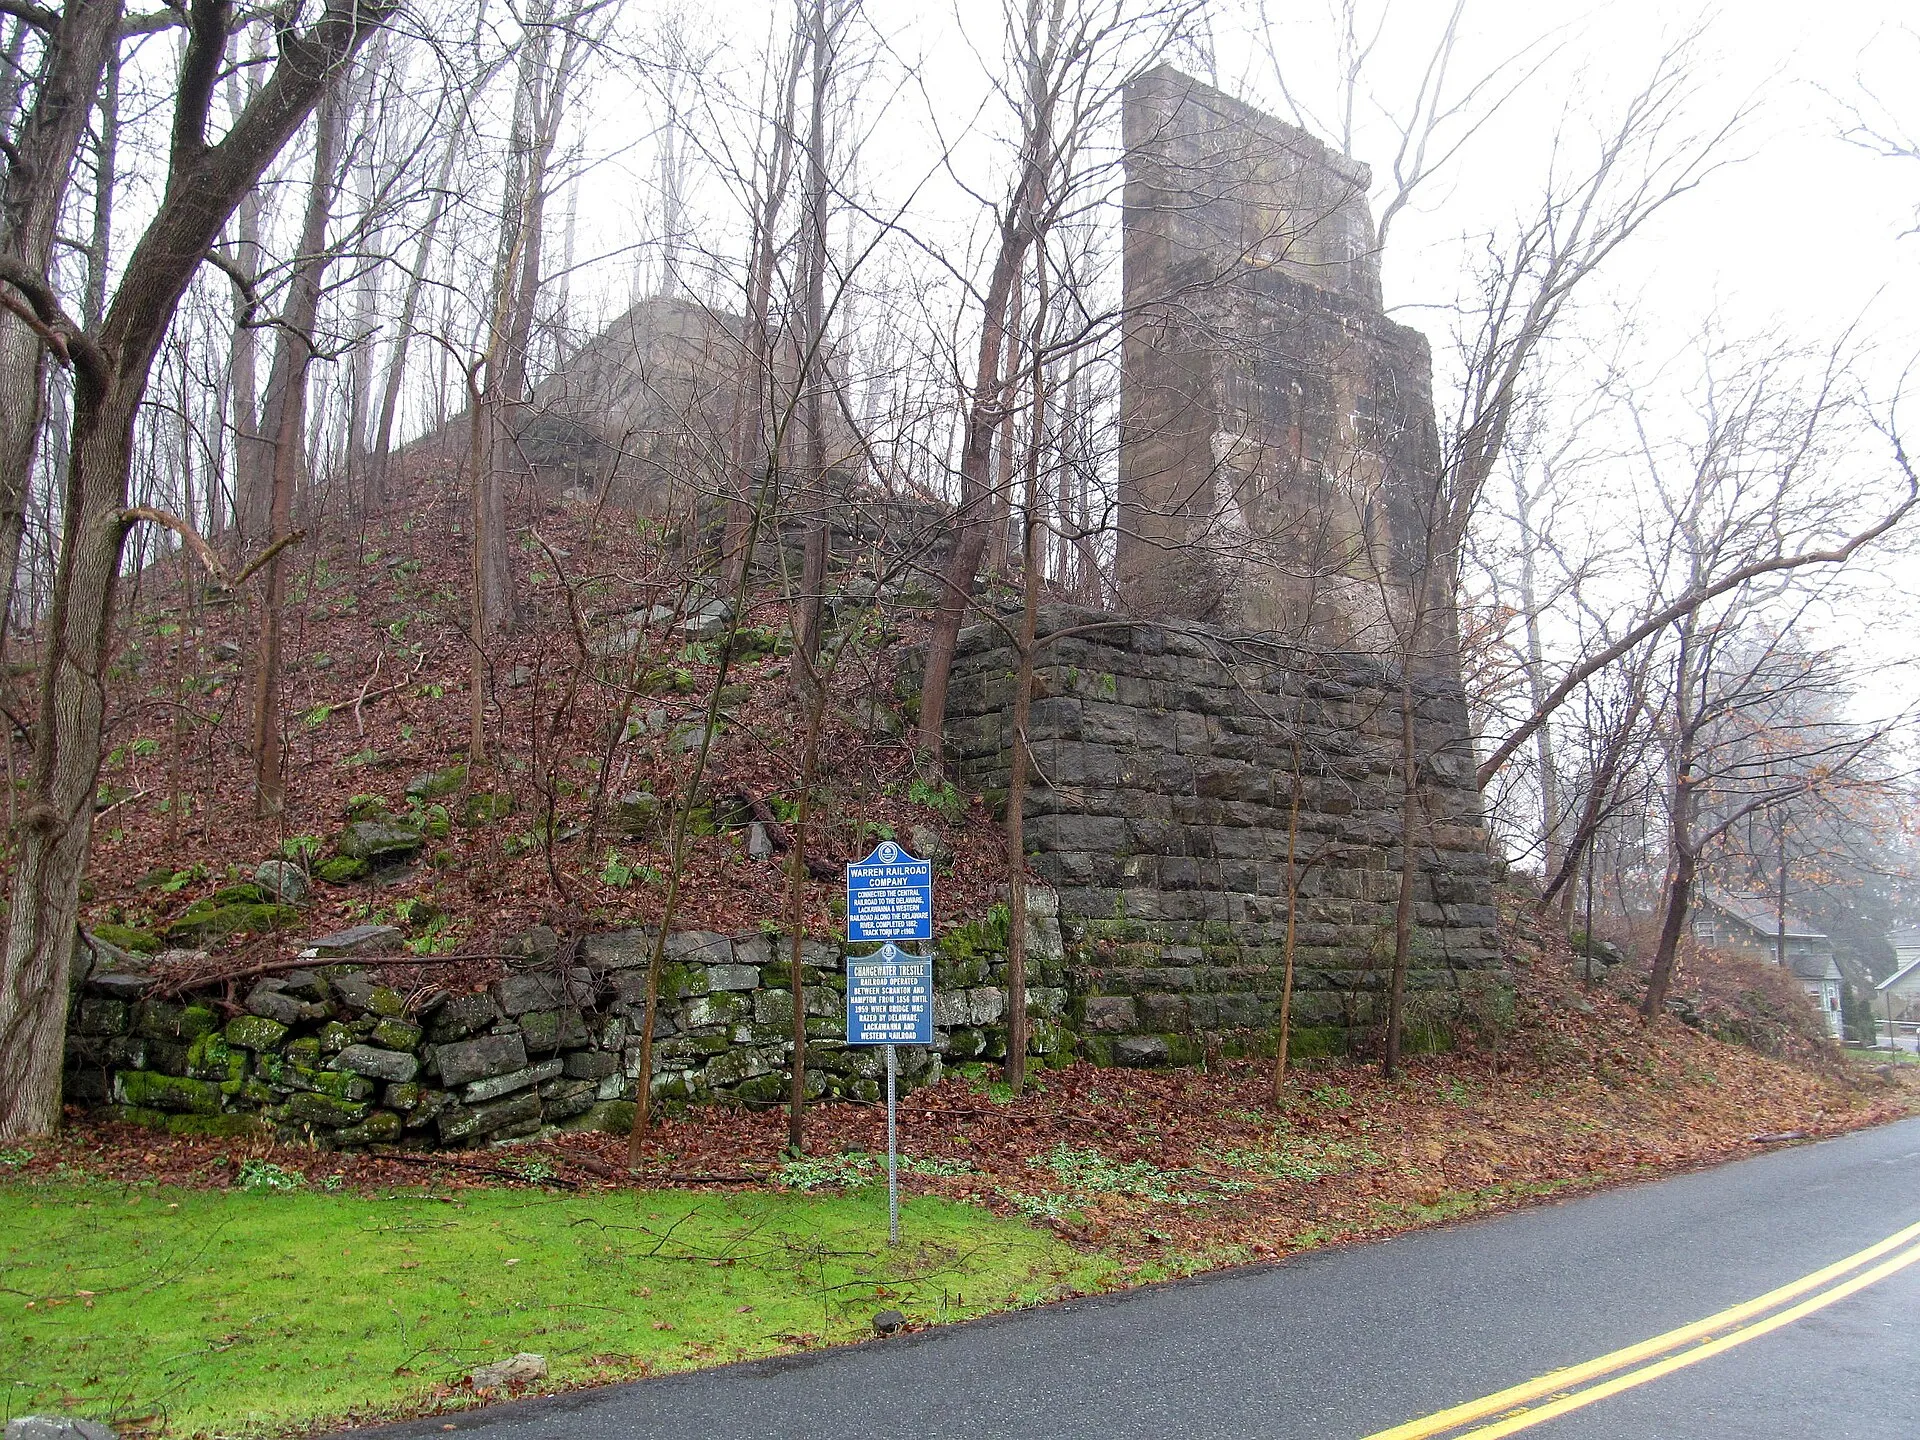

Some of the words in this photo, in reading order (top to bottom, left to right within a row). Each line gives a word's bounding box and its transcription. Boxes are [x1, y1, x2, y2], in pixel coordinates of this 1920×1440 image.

[851, 868, 883, 877] WARREN
[886, 867, 926, 876] RAILROAD
[869, 878, 907, 886] COMPANY
[854, 966, 896, 976] CHANGEWATER
[899, 965, 923, 975] TRESTLE
